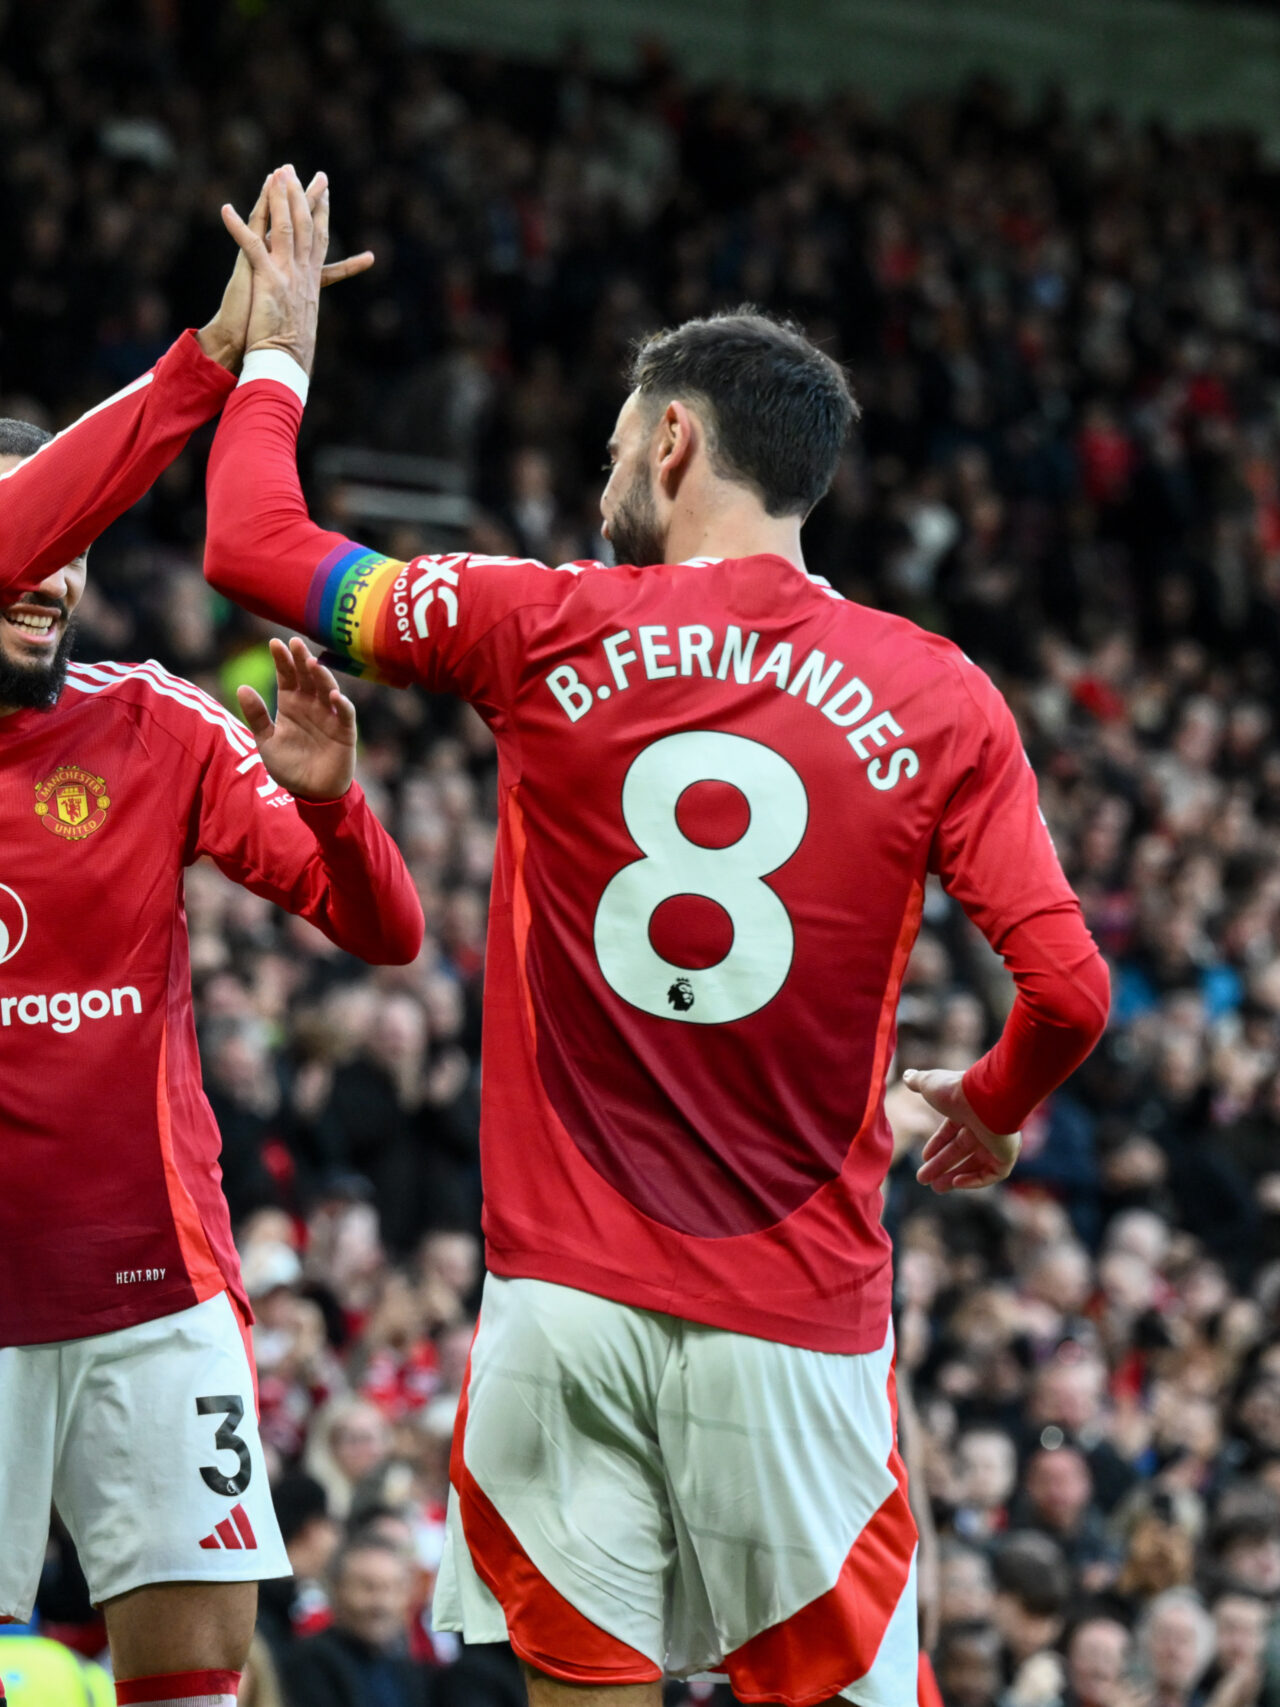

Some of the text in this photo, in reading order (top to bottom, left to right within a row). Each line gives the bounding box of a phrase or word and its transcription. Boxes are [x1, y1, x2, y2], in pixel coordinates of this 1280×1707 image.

[335, 557, 388, 647] aptain
[545, 624, 920, 791] B.FERNANDES
[41, 771, 101, 797] MANCHESTER
[55, 820, 97, 836] UNITED
[593, 730, 809, 1025] 8
[116, 1268, 166, 1285] HEAT.RDY
[195, 1394, 252, 1497] 3
